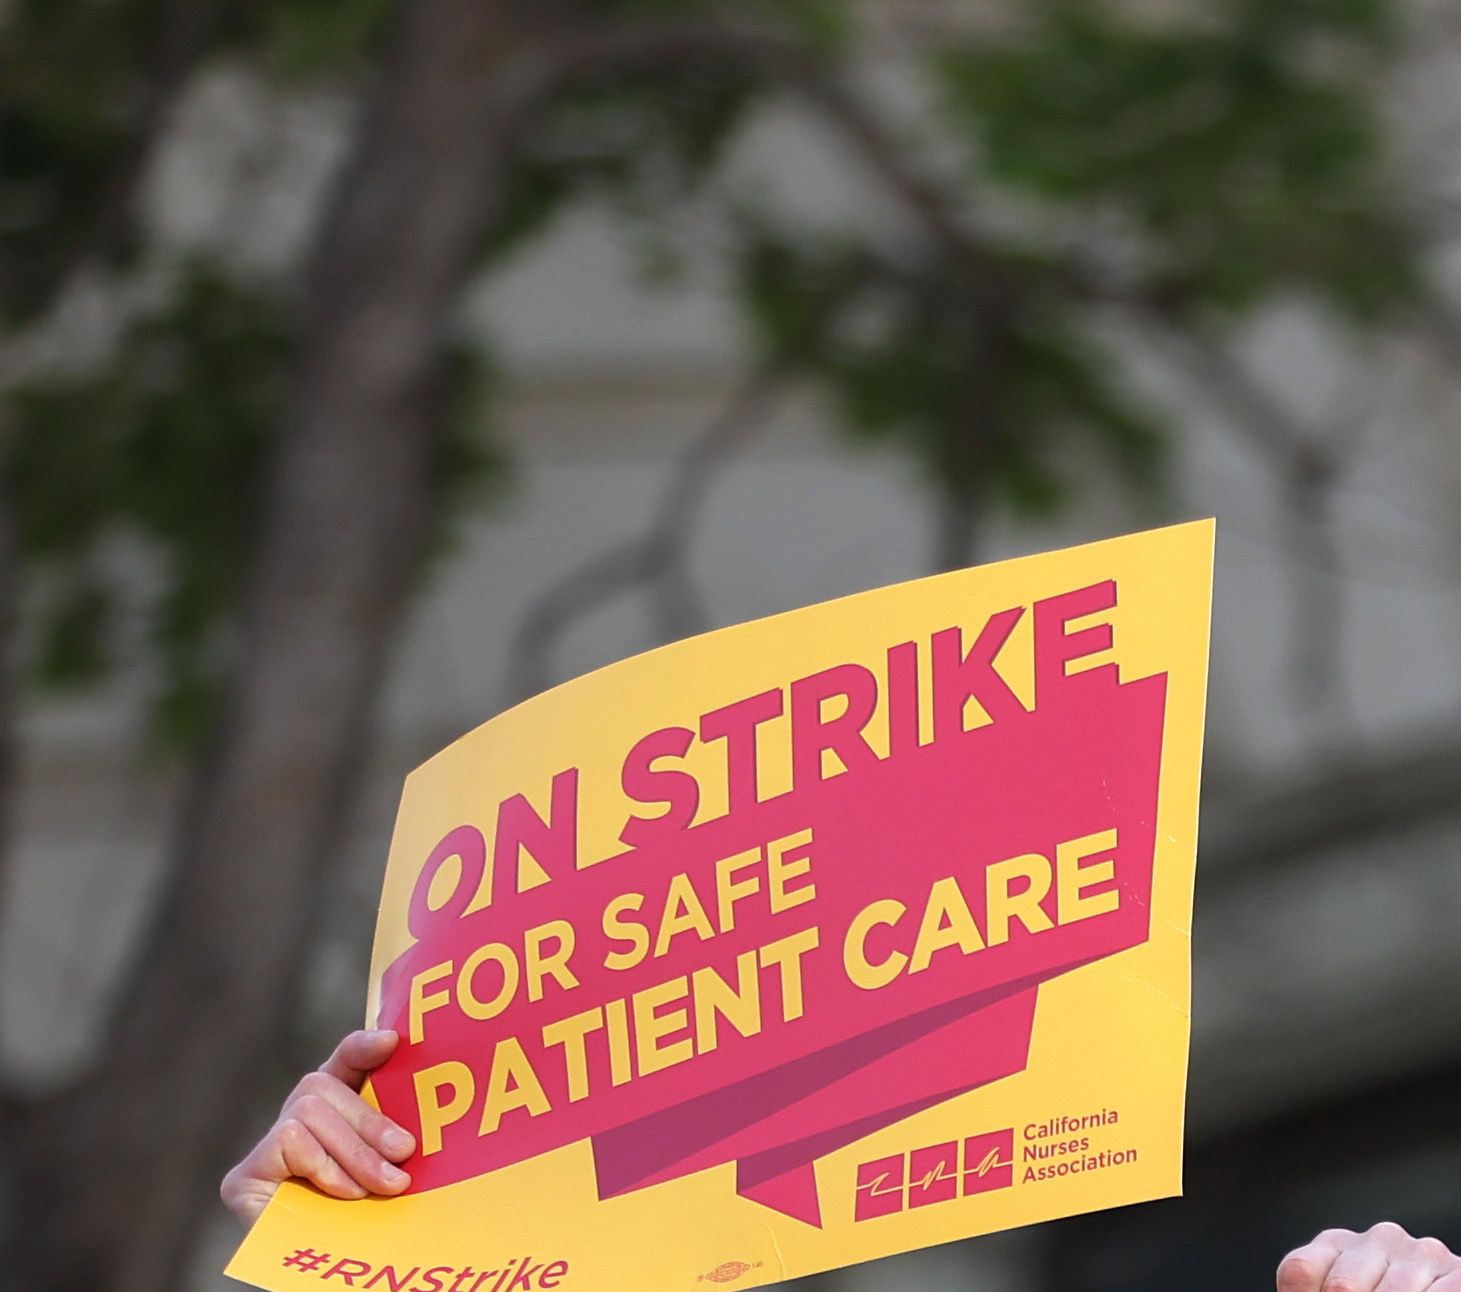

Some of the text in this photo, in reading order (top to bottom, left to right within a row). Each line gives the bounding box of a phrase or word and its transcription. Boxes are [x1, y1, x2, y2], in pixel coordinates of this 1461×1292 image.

[407, 579, 1120, 941] ON STRIKE
[407, 829, 816, 1044] FOR SAFE
[412, 828, 1120, 1157] PATIENT CARE
[1022, 1147, 1138, 1185] Association
[1023, 1108, 1119, 1141] California
[1023, 1137, 1090, 1163] Nurses
